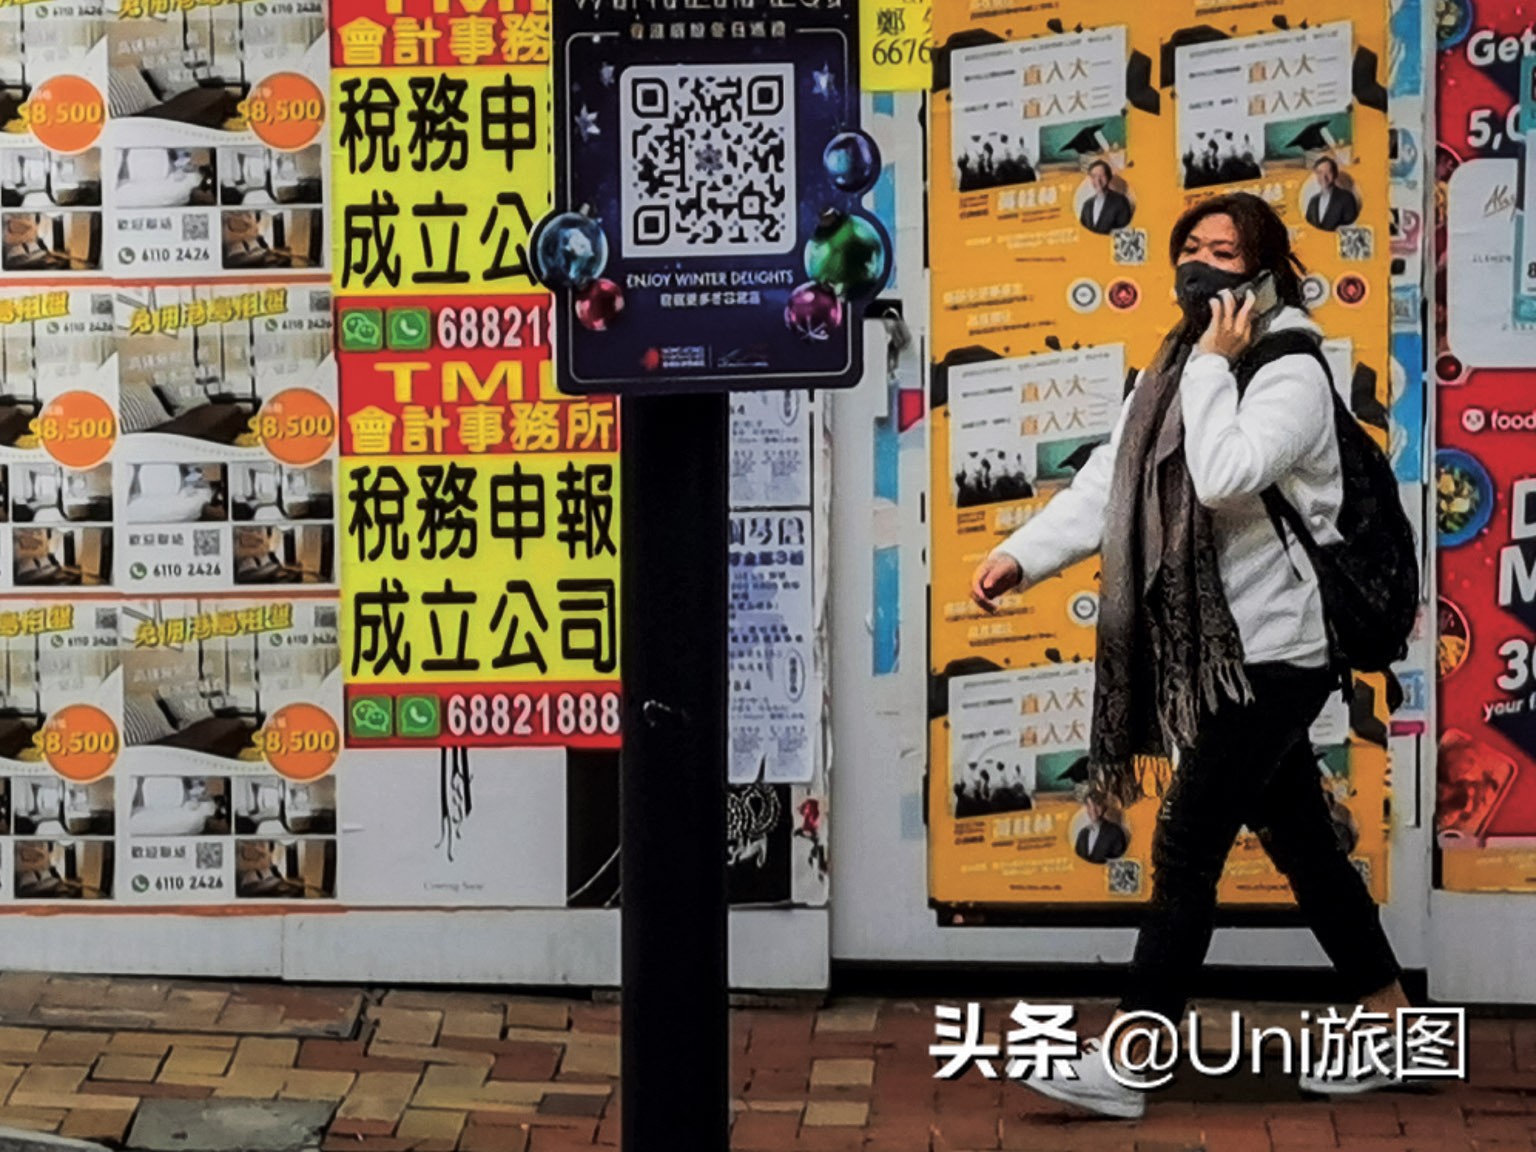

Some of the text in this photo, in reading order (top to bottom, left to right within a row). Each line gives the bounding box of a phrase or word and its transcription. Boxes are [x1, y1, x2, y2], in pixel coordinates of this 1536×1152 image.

[16, 101, 101, 127] $8,500
[236, 98, 321, 124] $8,500
[141, 248, 209, 263] 6110 2426
[626, 269, 794, 289] ENJOY WINTER DELIGHTS
[28, 417, 113, 444] $8,500
[247, 414, 332, 440] $8,500
[347, 402, 614, 453] 會計事務所
[349, 460, 617, 562] 稅務申報
[153, 563, 221, 578] 6110 2426
[351, 577, 617, 677] 成立公司
[447, 693, 620, 734] 68821888
[31, 730, 115, 754] $8,500
[251, 728, 336, 753] $8,500
[155, 875, 223, 890] 6110 2426
